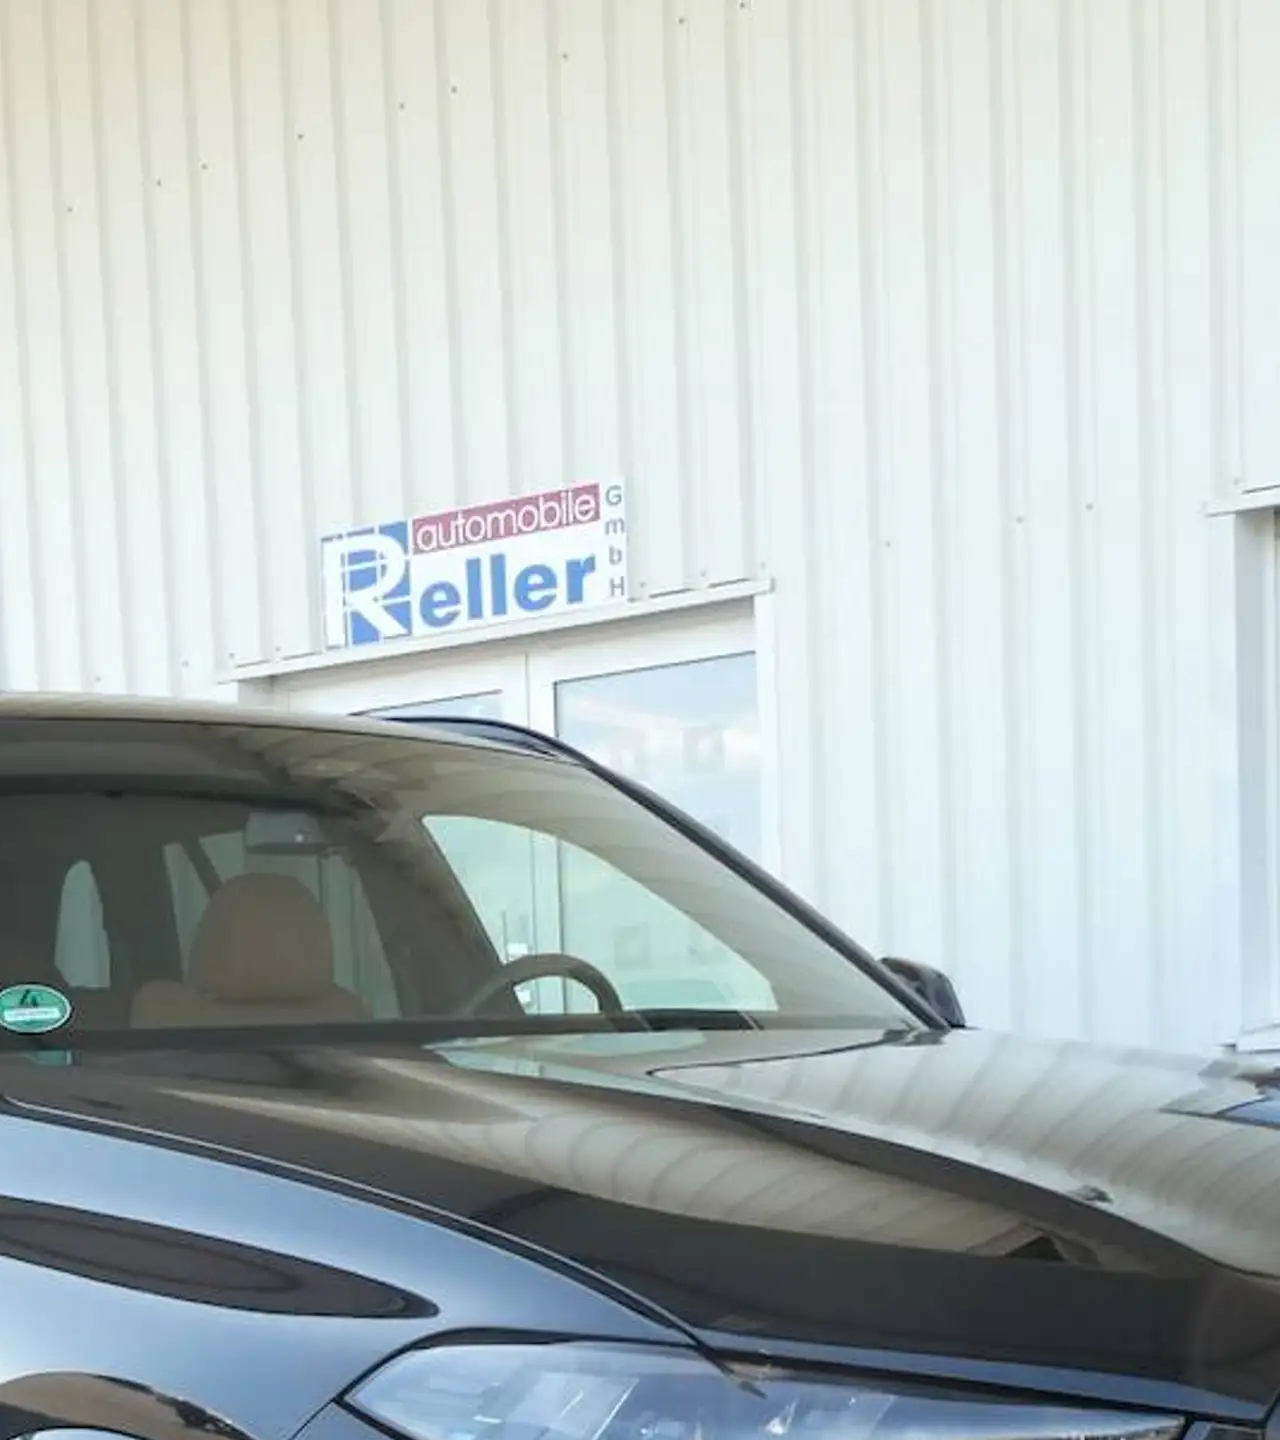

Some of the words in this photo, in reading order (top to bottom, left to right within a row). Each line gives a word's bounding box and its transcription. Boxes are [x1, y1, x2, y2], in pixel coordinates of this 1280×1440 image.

[415, 489, 597, 552] automobile
[604, 485, 626, 598] GmbH
[322, 522, 596, 650] Reller
